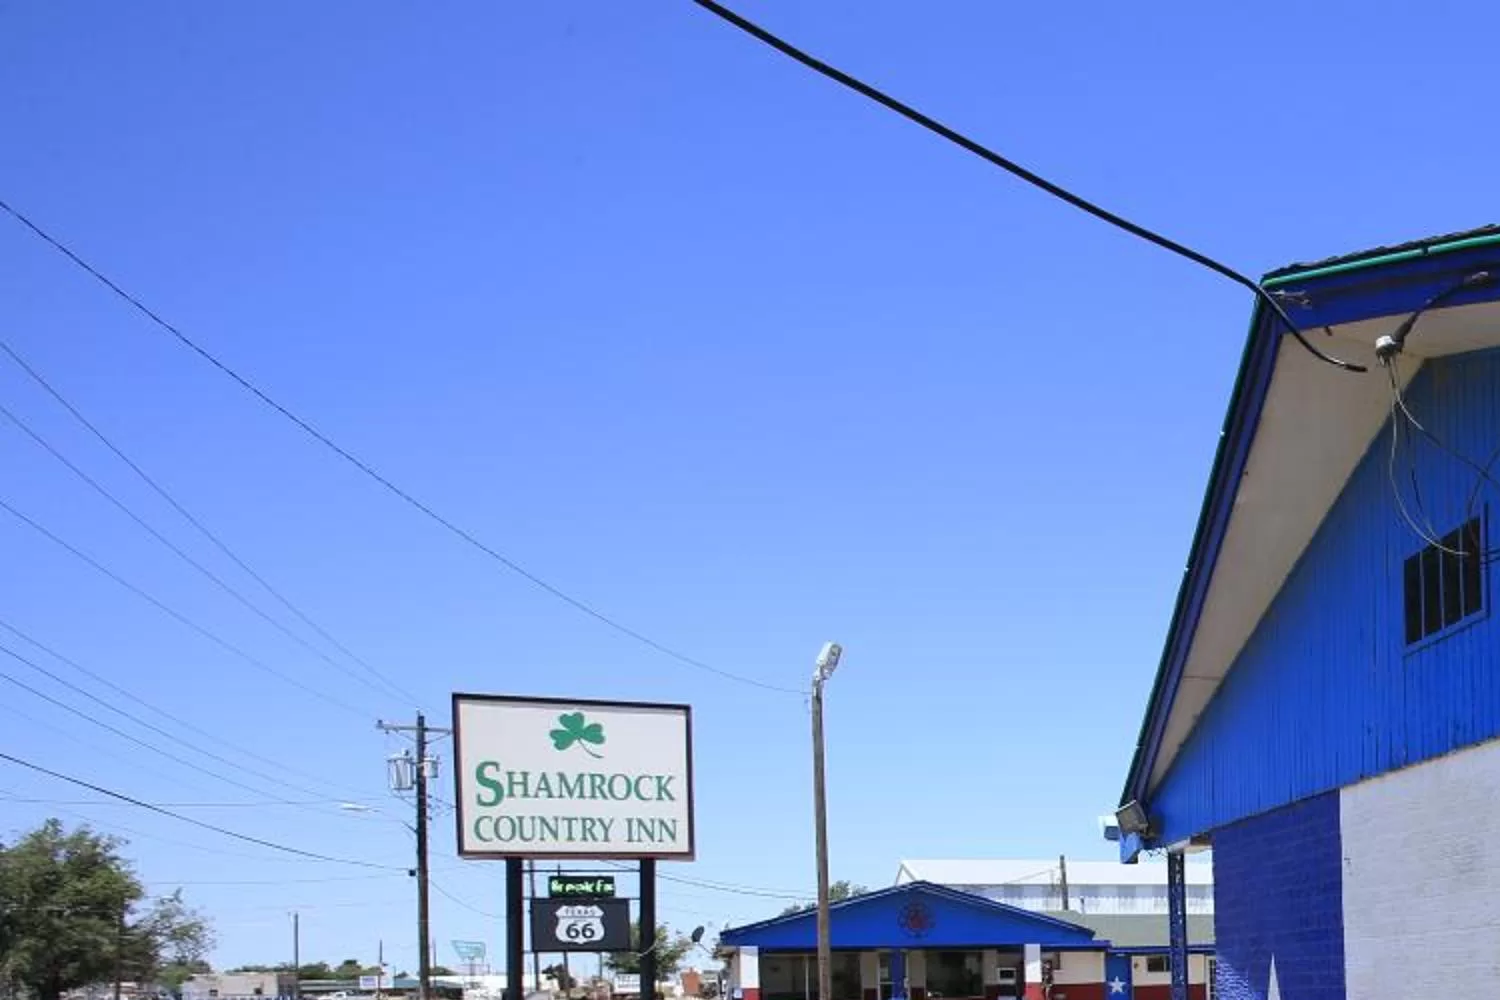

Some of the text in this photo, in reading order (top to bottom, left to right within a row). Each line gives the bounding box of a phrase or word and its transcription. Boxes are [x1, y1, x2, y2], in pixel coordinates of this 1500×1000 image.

[475, 761, 676, 807] SHAMROCK
[473, 815, 679, 843] COUNTRY INN
[565, 923, 595, 939] 66
